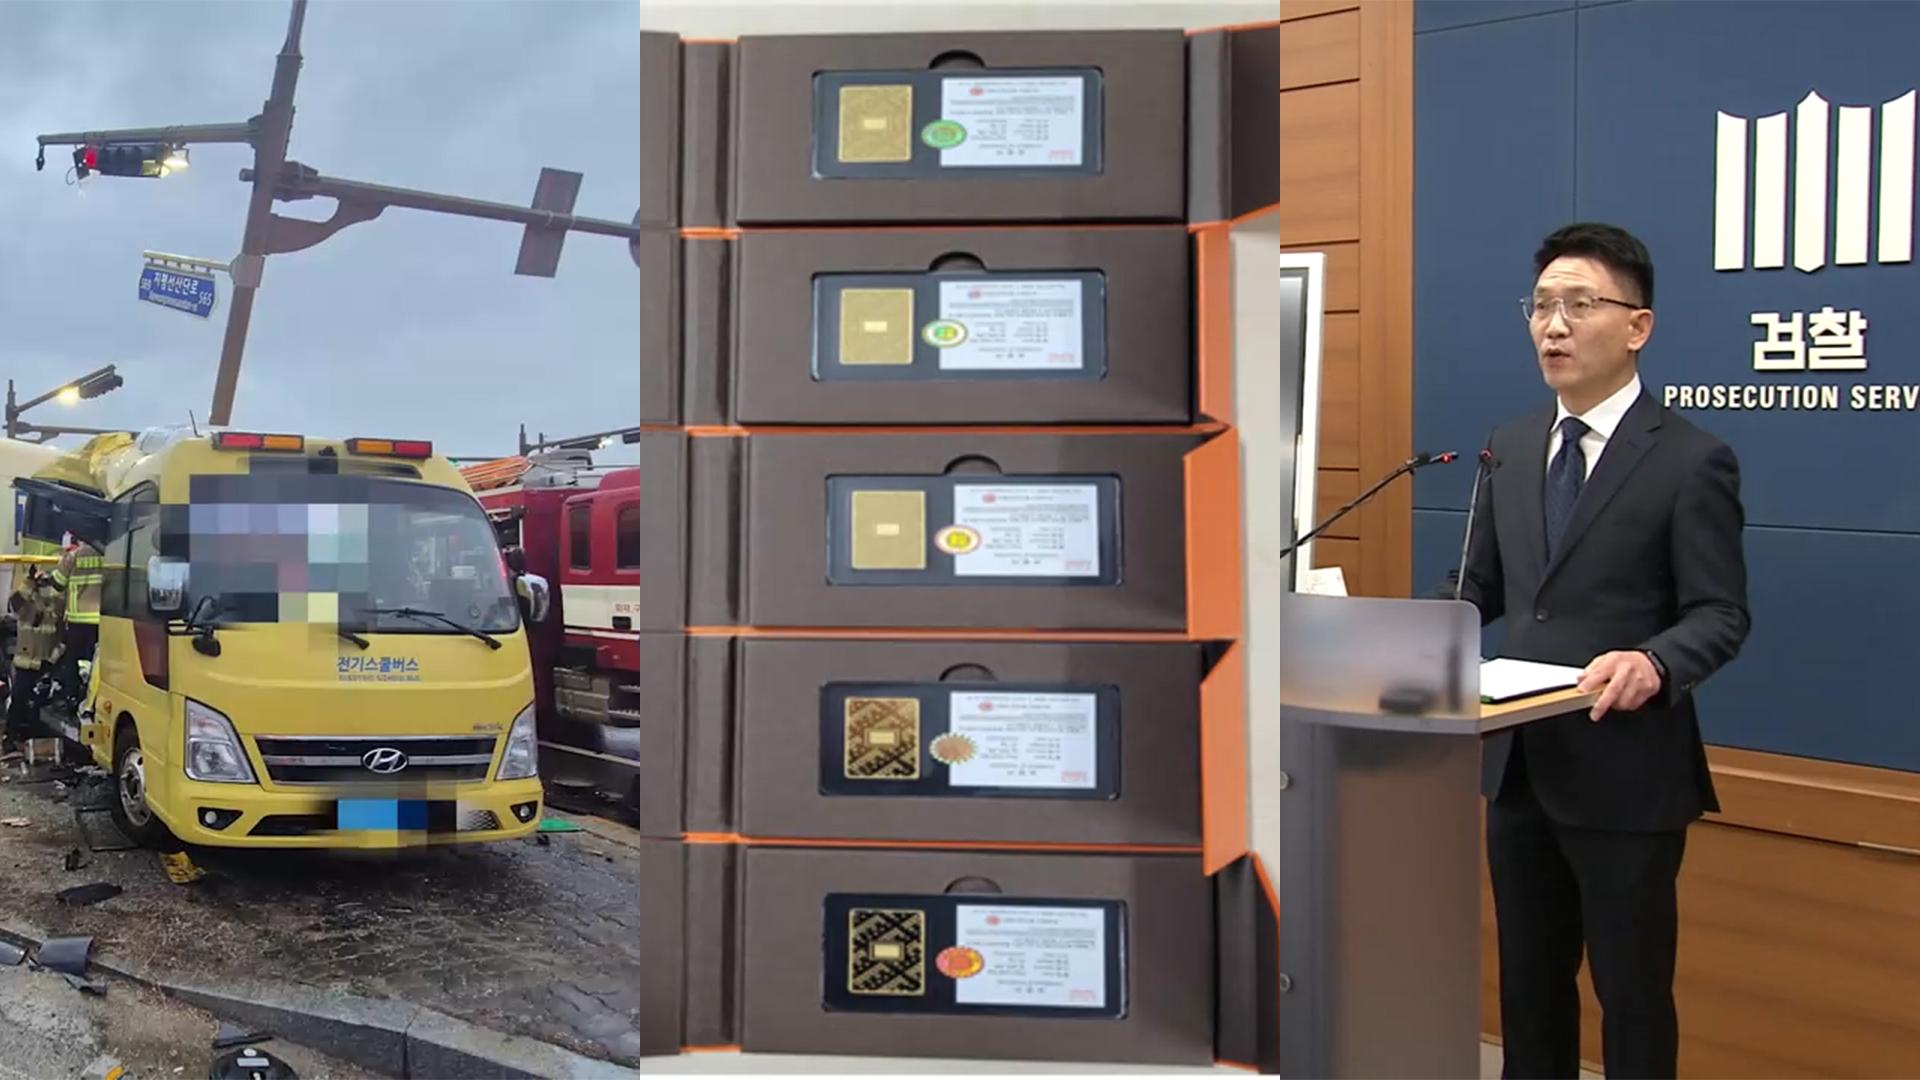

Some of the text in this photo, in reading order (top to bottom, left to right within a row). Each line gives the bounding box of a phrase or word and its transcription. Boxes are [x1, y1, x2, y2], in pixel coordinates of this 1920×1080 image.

[1751, 307, 1867, 370] 검찰
[1663, 385, 1839, 410] PROSECUTION
[337, 656, 419, 672] 전기스쿨버스
